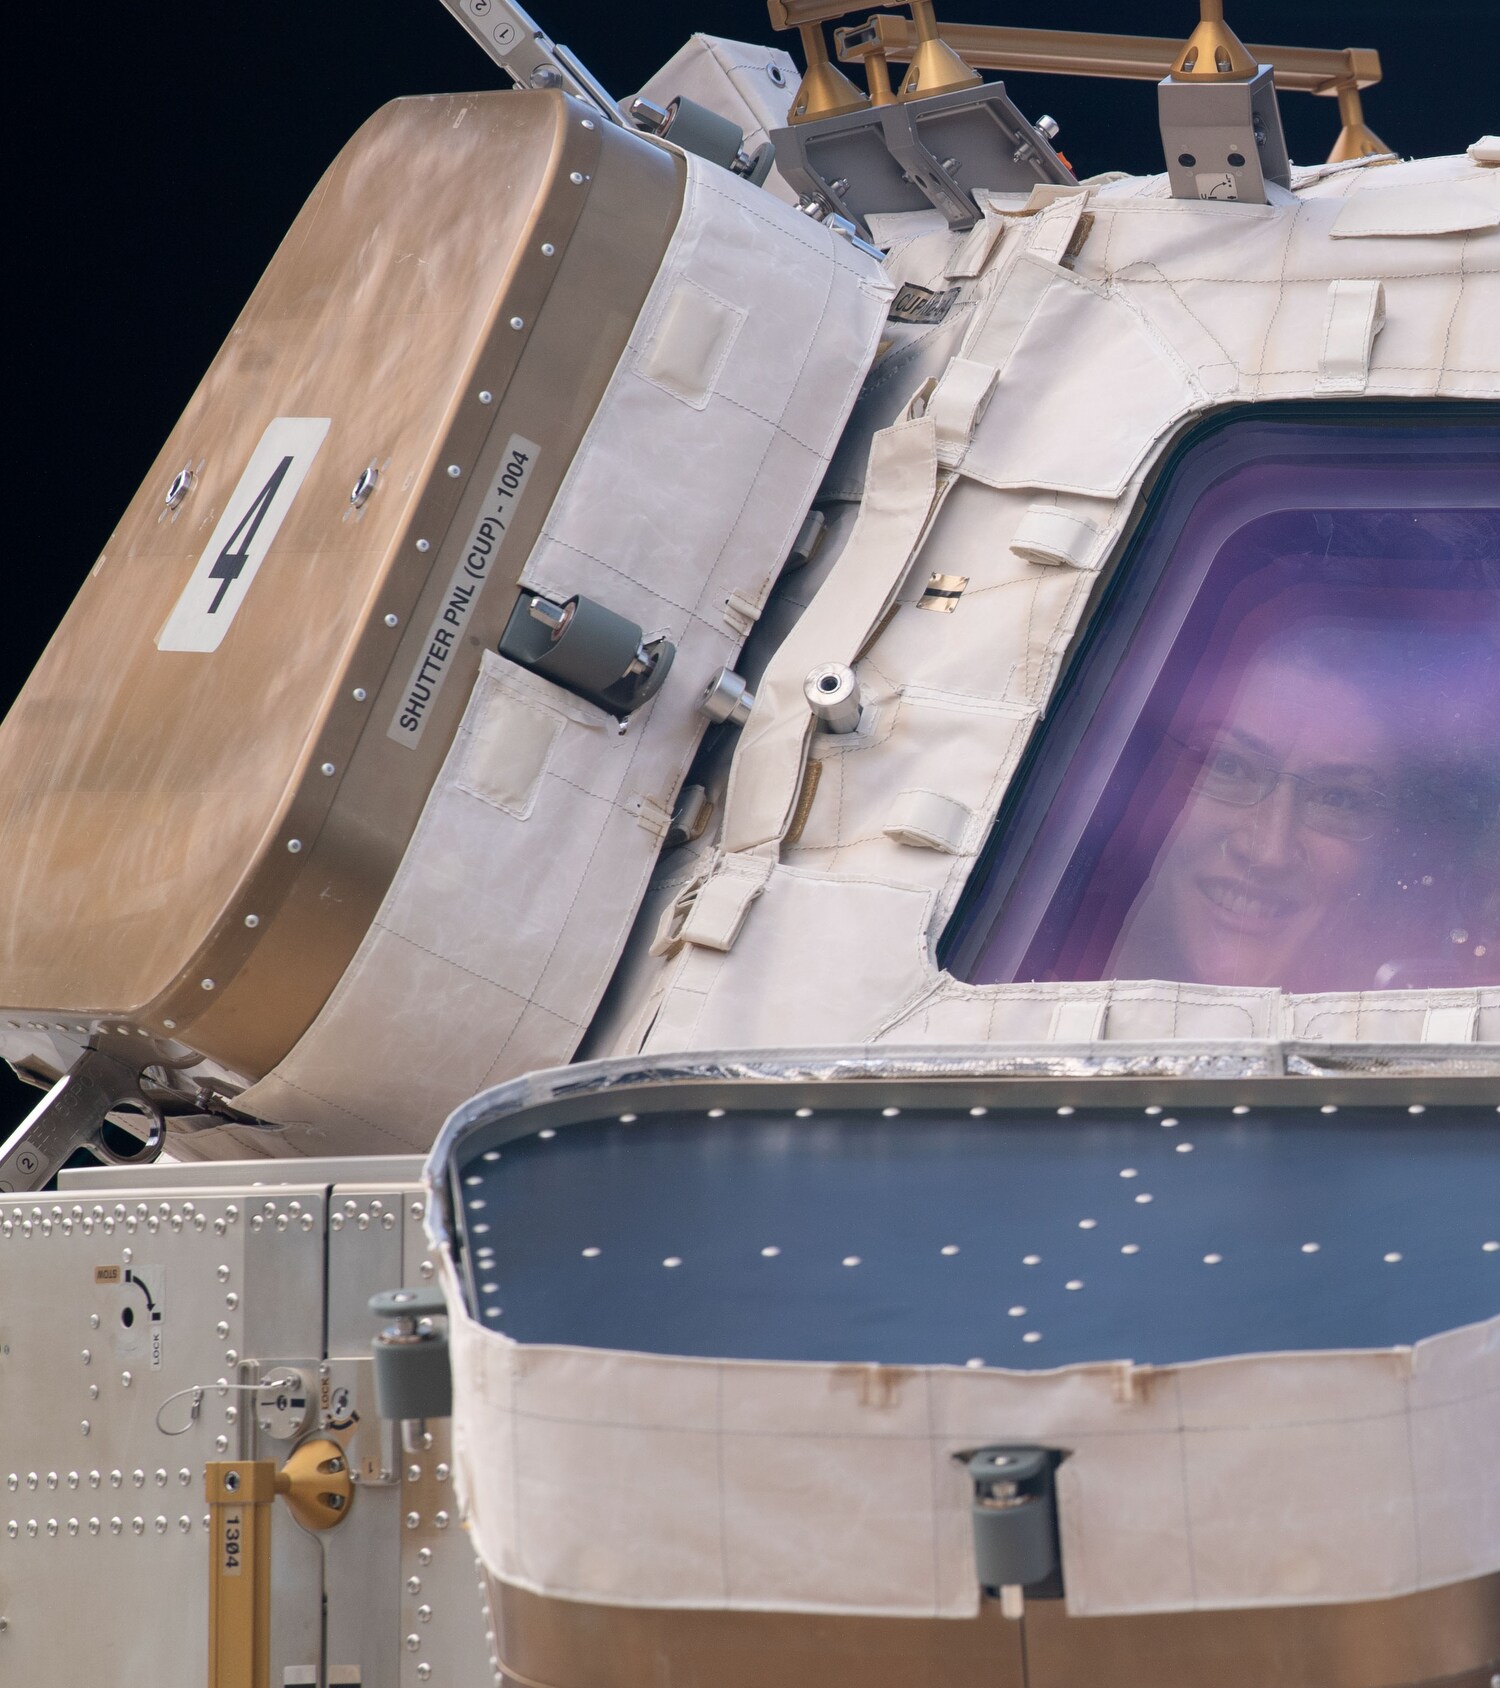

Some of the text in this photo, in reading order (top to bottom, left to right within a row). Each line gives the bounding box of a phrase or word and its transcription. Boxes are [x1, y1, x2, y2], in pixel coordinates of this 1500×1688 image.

[207, 456, 295, 614] 4
[400, 627, 456, 732] SHUTTER
[443, 585, 476, 627] PNL
[464, 516, 505, 580] (CUP)
[497, 450, 530, 498] 1004
[97, 1269, 118, 1280] STOW
[321, 1377, 330, 1410] LOCK
[225, 1515, 240, 1568] 1304
